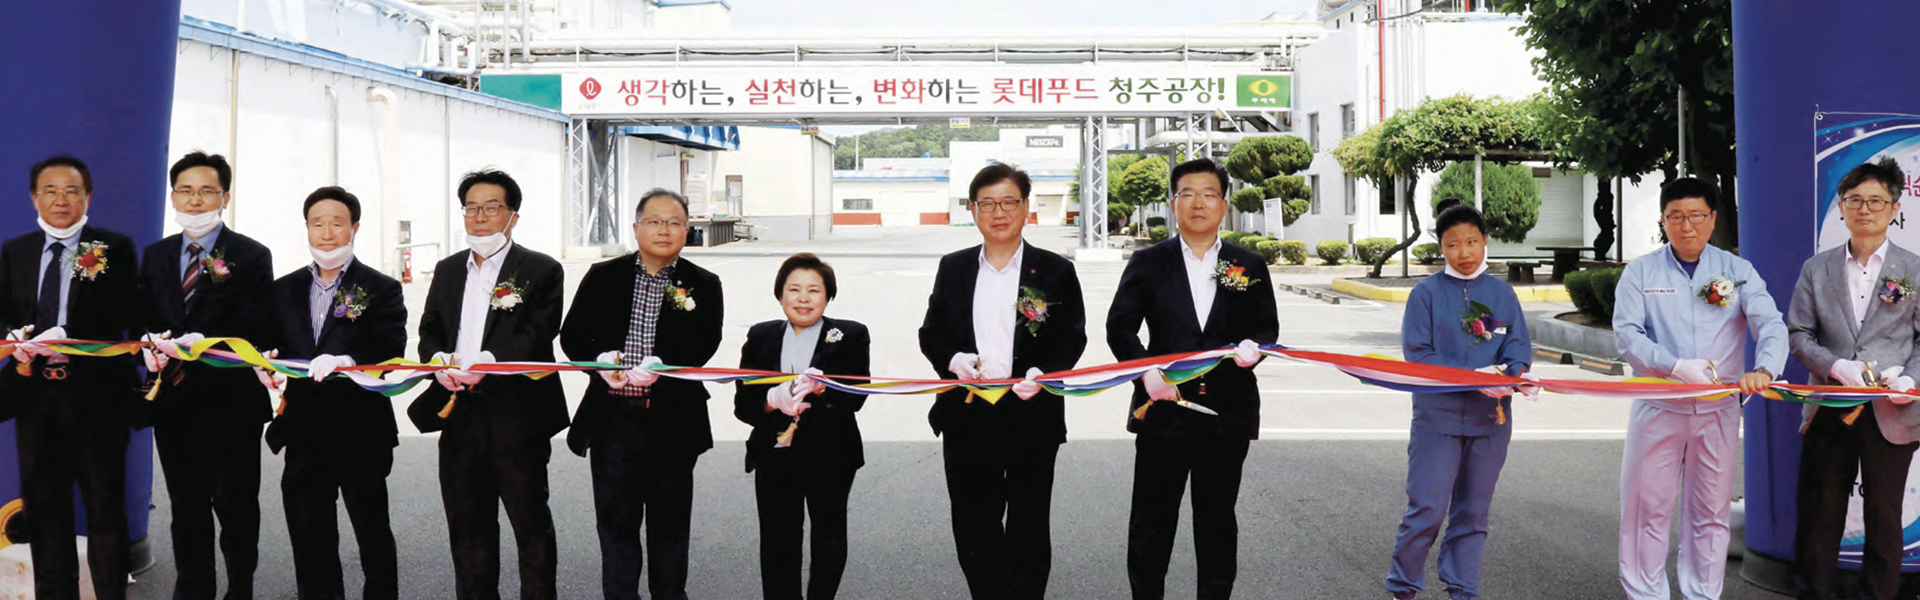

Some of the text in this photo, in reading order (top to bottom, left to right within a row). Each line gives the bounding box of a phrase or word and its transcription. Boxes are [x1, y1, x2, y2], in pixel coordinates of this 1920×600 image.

[617, 77, 1225, 107] 생각하는, 실천하는, 변화하는 롯데푸드 청주공장!
